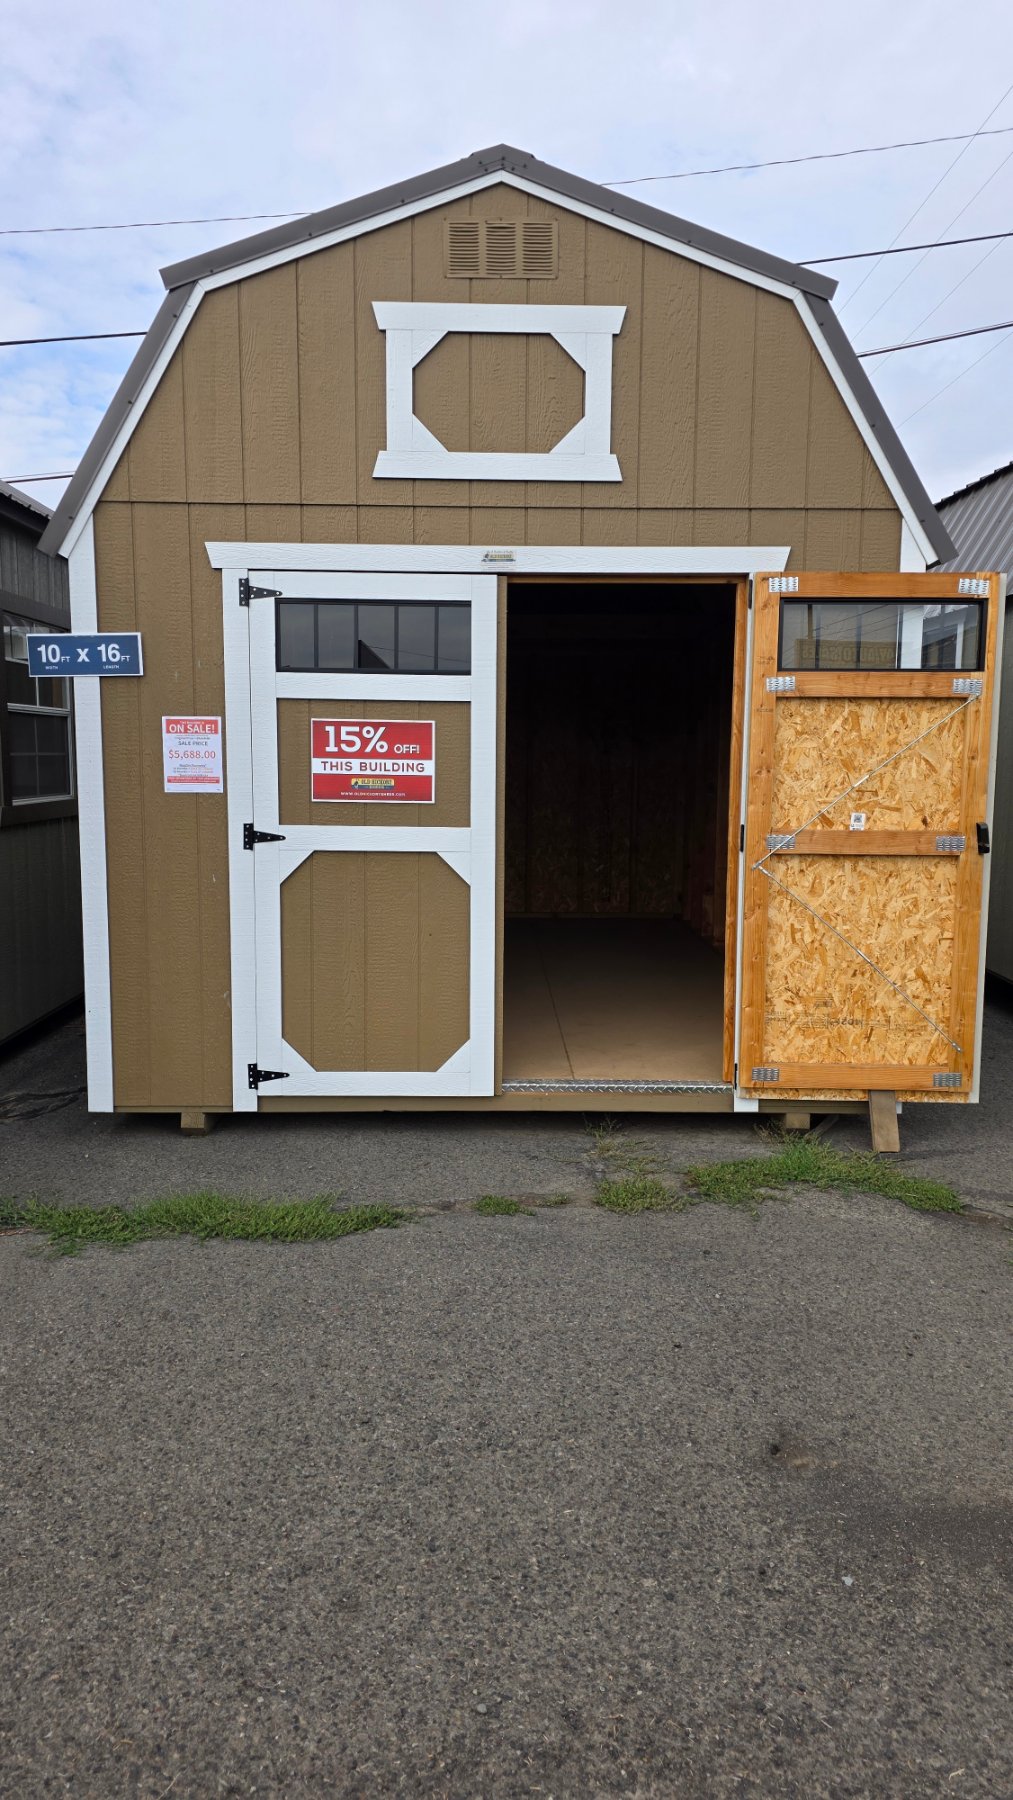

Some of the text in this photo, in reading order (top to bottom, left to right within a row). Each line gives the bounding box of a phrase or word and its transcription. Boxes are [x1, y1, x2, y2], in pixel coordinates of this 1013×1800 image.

[169, 723, 215, 733] ON SALE!
[325, 725, 420, 754] 15% OFF!
[168, 748, 216, 760] $5,688.00
[321, 761, 425, 773] THIS BUILDING
